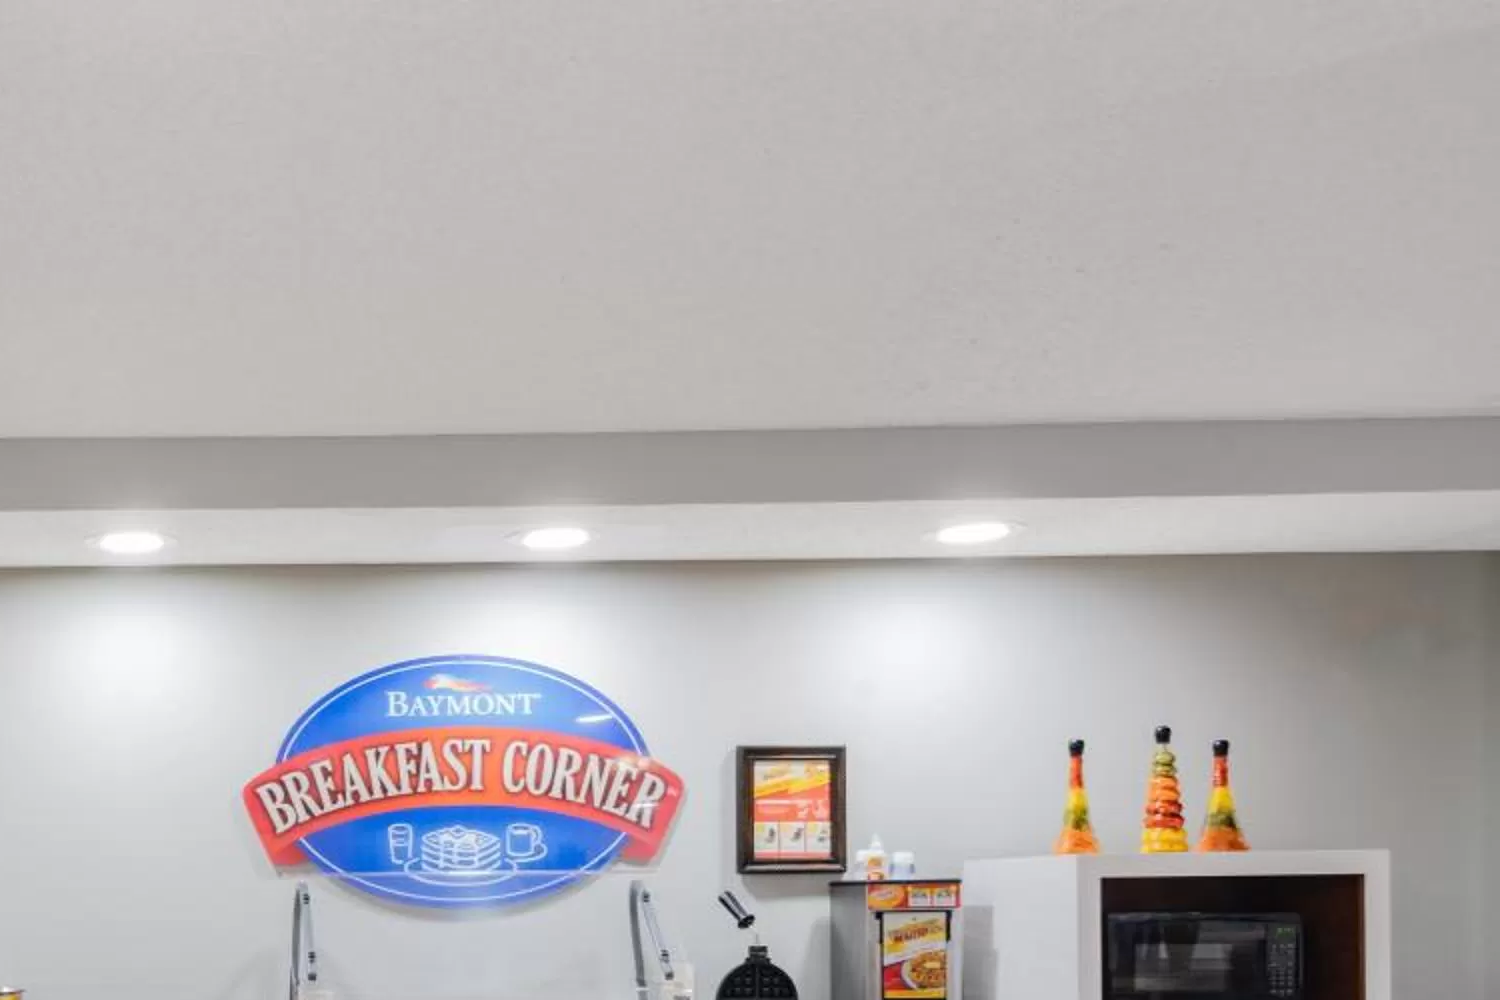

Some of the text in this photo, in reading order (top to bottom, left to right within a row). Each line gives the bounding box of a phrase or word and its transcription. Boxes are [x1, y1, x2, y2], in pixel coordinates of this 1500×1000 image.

[385, 691, 537, 717] BAYMONT
[256, 738, 669, 834] BREAKFAST CORNER
